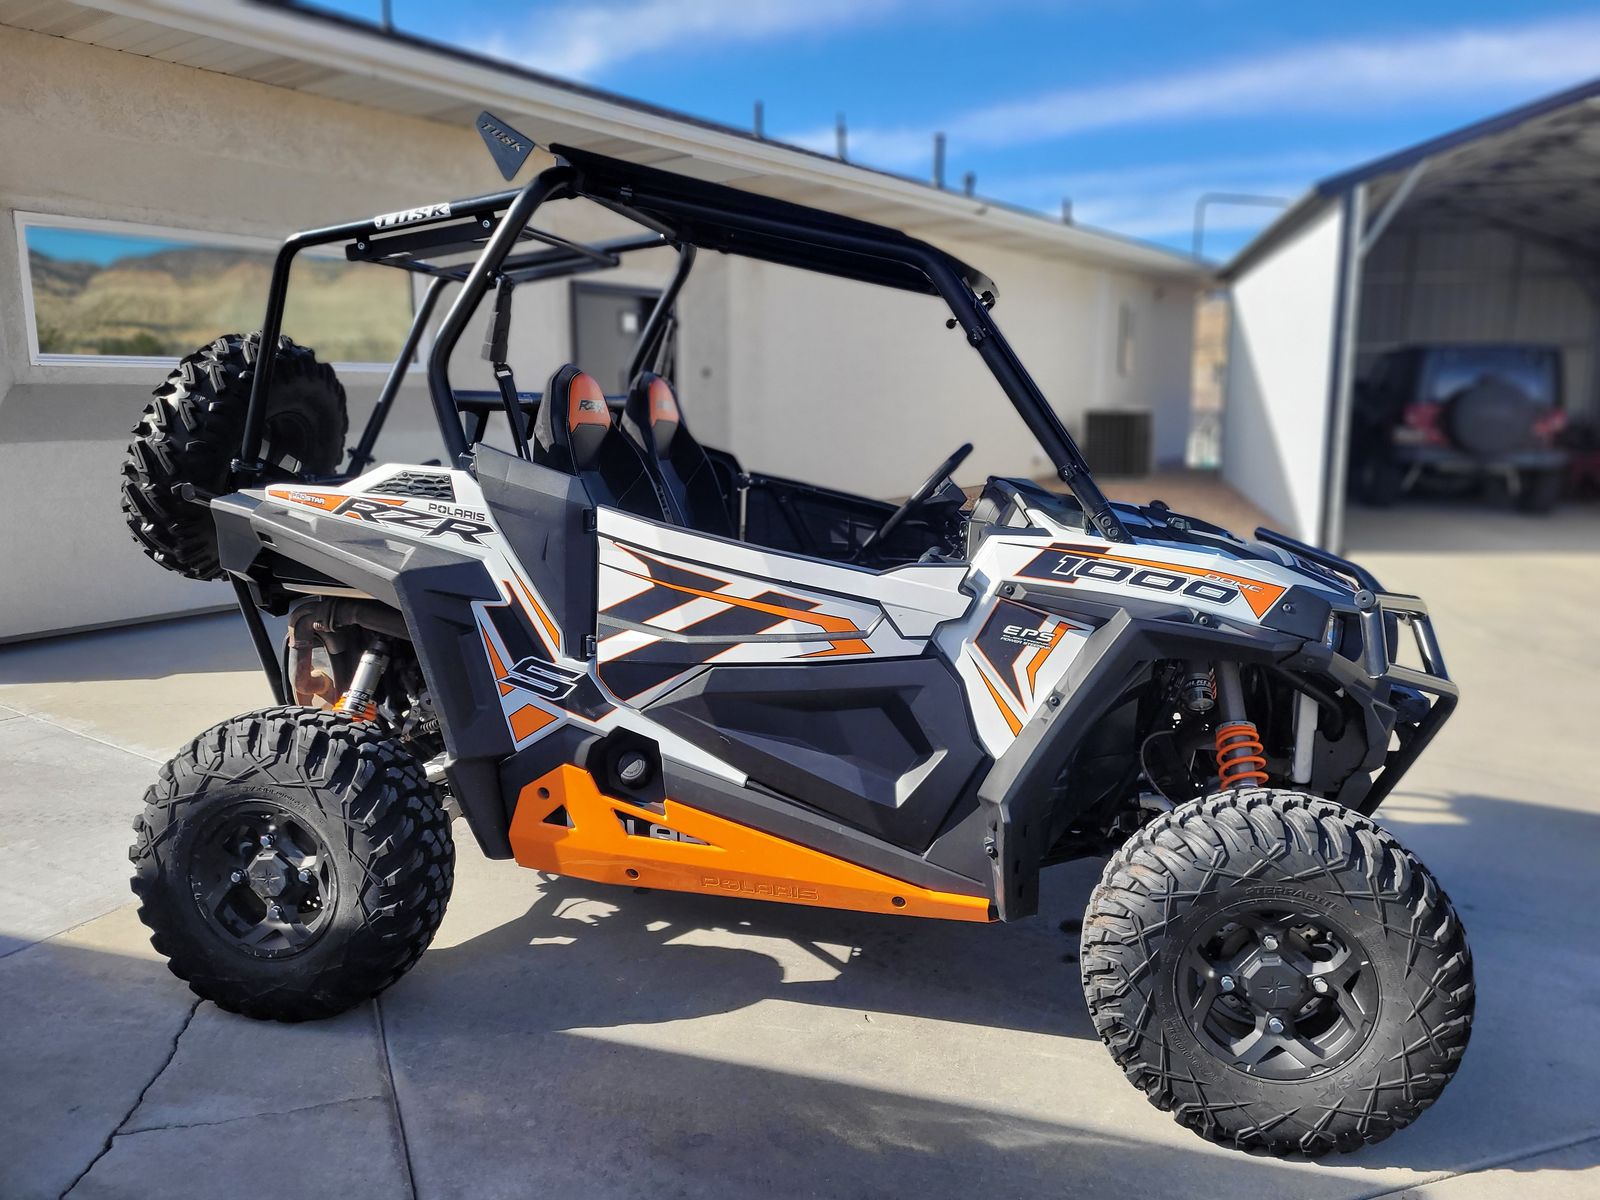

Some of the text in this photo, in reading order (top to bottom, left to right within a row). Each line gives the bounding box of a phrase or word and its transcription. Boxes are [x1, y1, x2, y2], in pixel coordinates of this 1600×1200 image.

[481, 121, 526, 152] TUSK
[377, 204, 448, 228] TUSK
[333, 496, 498, 548] RZR
[427, 502, 486, 522] POLARIS
[1052, 554, 1242, 607] 1000
[1003, 624, 1056, 643] EPS
[702, 877, 820, 901] POLARIS
